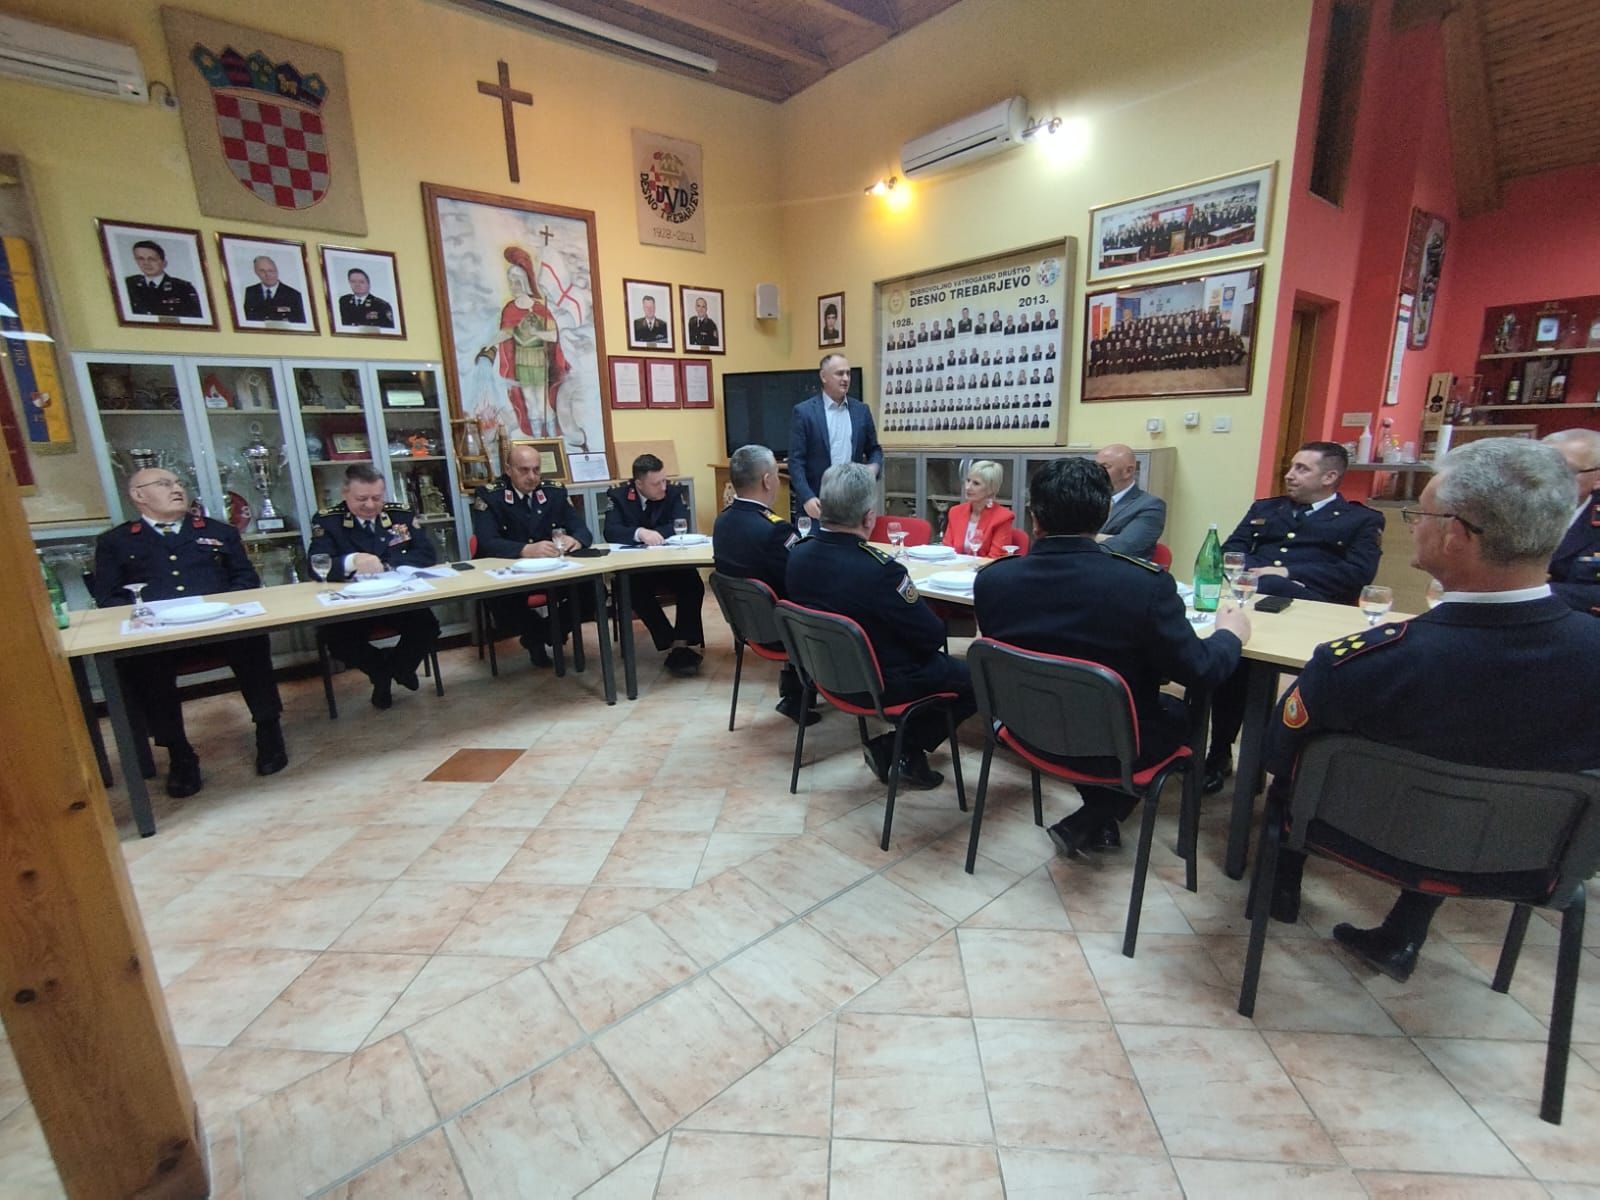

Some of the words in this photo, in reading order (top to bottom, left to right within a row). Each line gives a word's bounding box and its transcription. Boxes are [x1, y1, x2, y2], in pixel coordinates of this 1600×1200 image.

[954, 273, 996, 288] VATROGASNO
[910, 291, 946, 308] DESNO
[950, 275, 1031, 300] TREBARJEVO
[1018, 294, 1049, 308] 2013.
